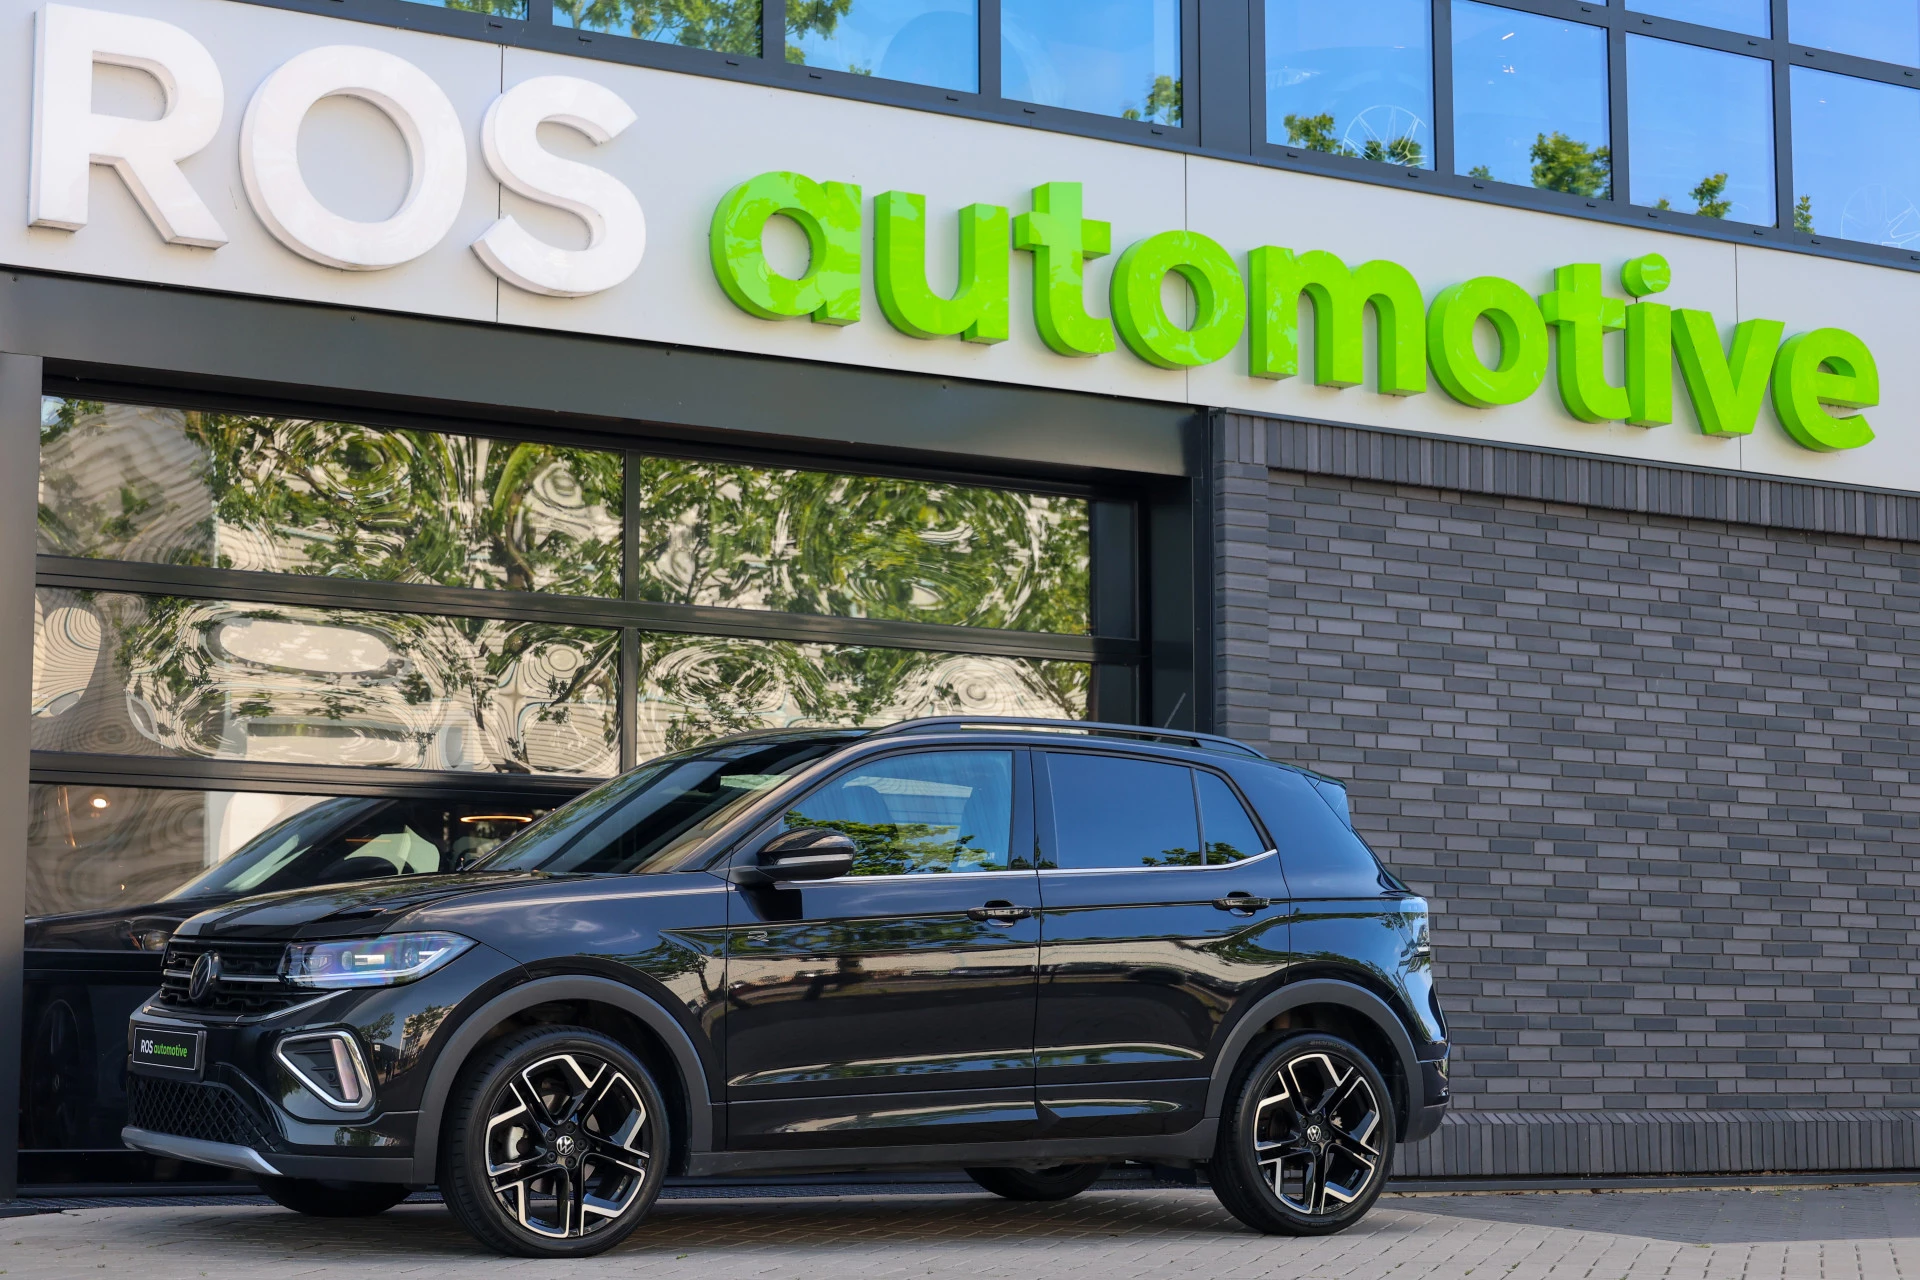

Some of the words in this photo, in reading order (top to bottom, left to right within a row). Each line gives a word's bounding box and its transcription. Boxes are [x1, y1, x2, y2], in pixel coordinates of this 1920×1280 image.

[27, 3, 647, 299] ROS
[709, 171, 1880, 453] automotive
[140, 1039, 153, 1054] ROS
[153, 1043, 188, 1057] automotive
